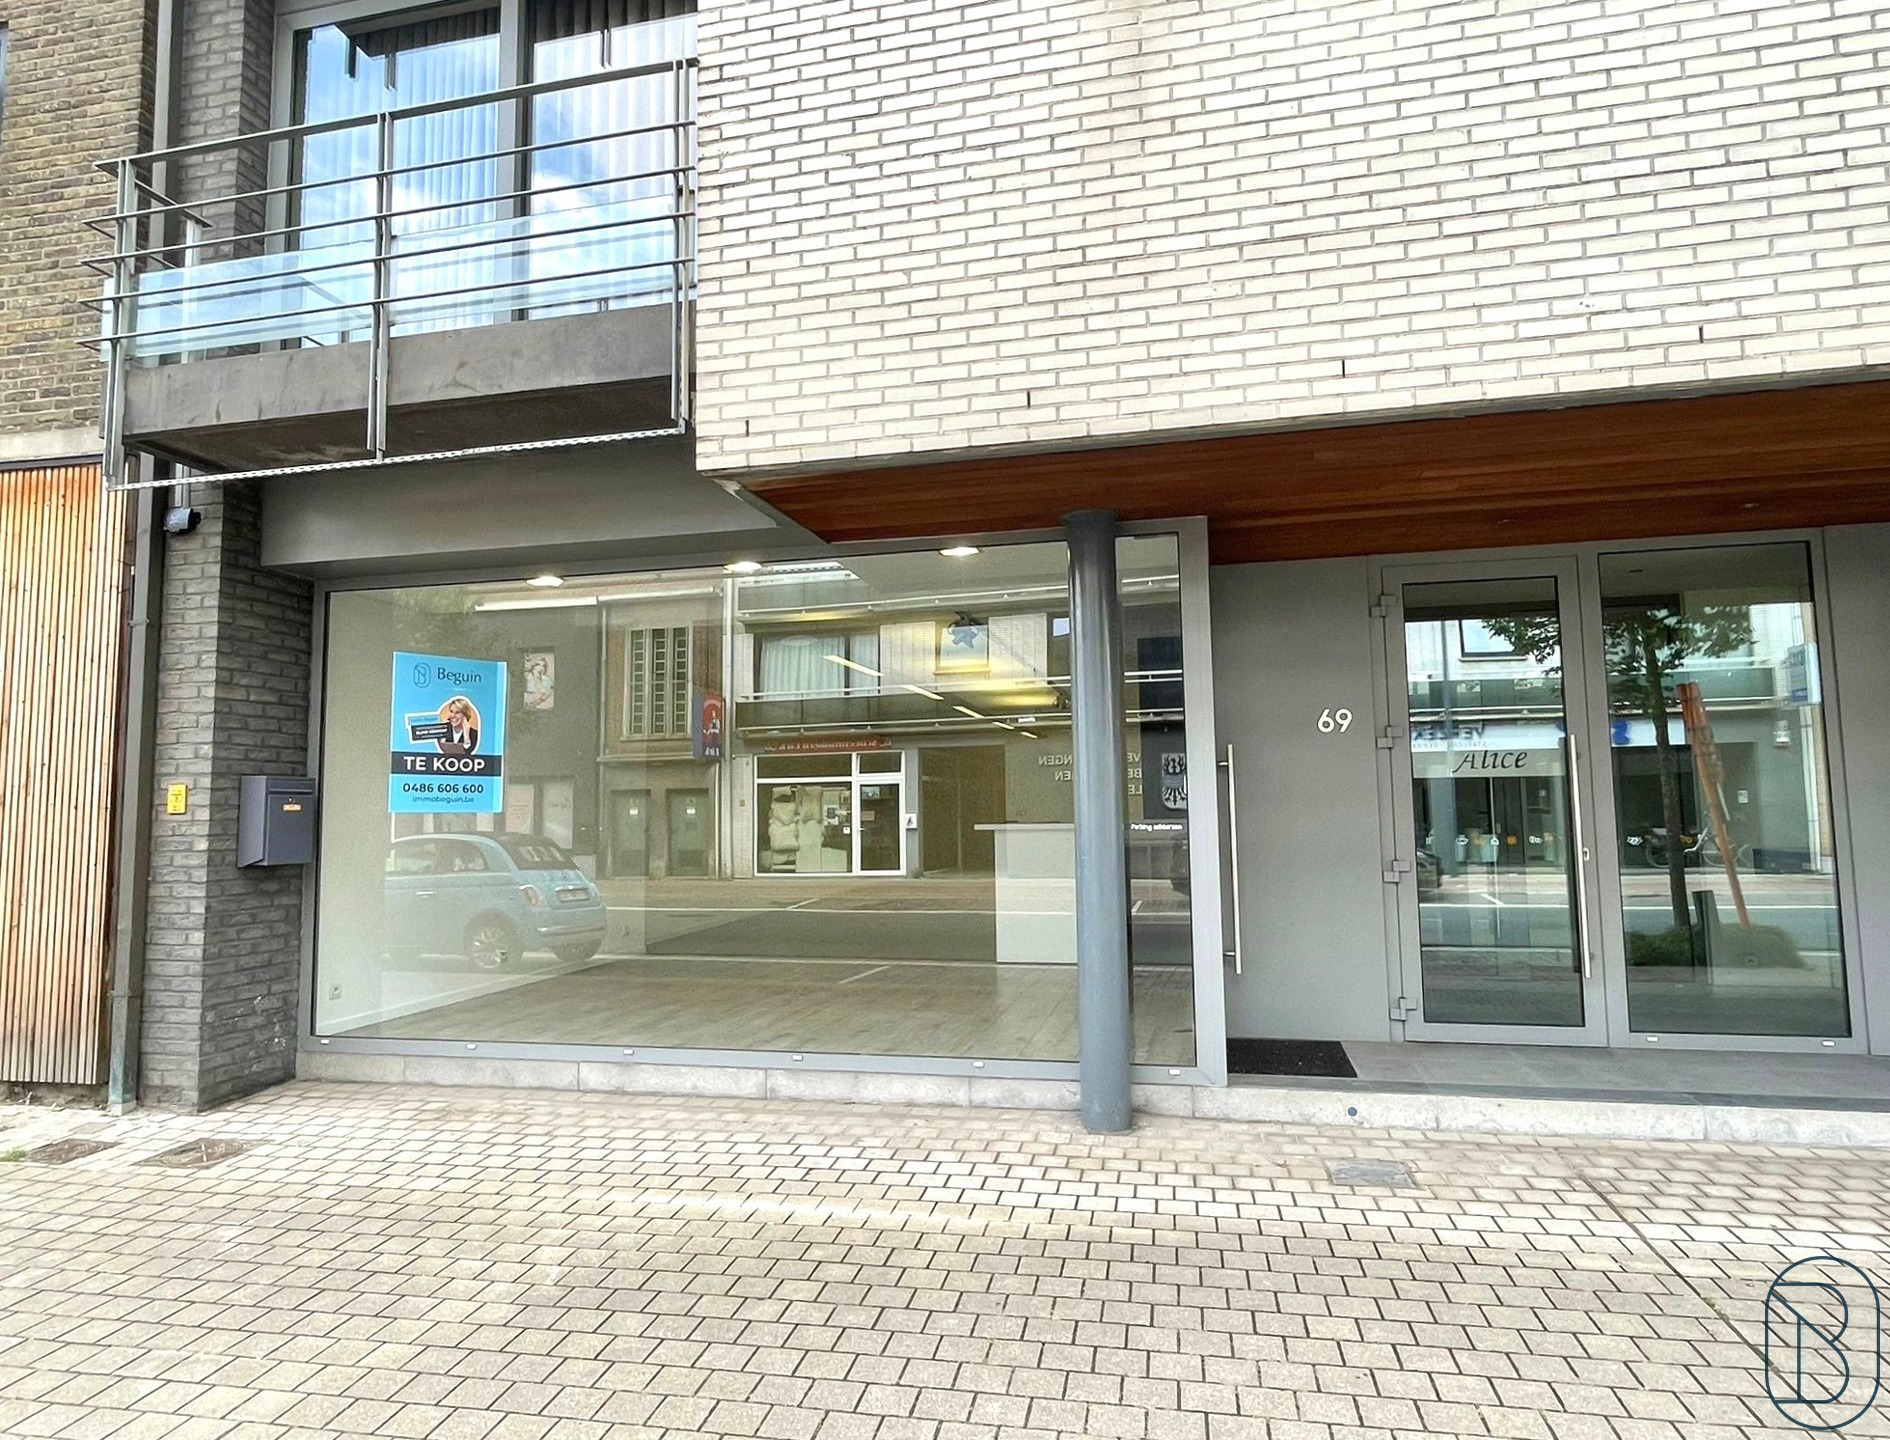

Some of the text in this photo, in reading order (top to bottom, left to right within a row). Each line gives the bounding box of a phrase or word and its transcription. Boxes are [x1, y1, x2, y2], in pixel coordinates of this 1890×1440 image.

[437, 667, 482, 686] Beguin
[1316, 708, 1353, 734] 69
[403, 756, 486, 773] TE KOOP
[1452, 750, 1528, 774] Alice
[402, 782, 484, 794] 0486 606 600
[412, 795, 475, 804] immobeguin.be
